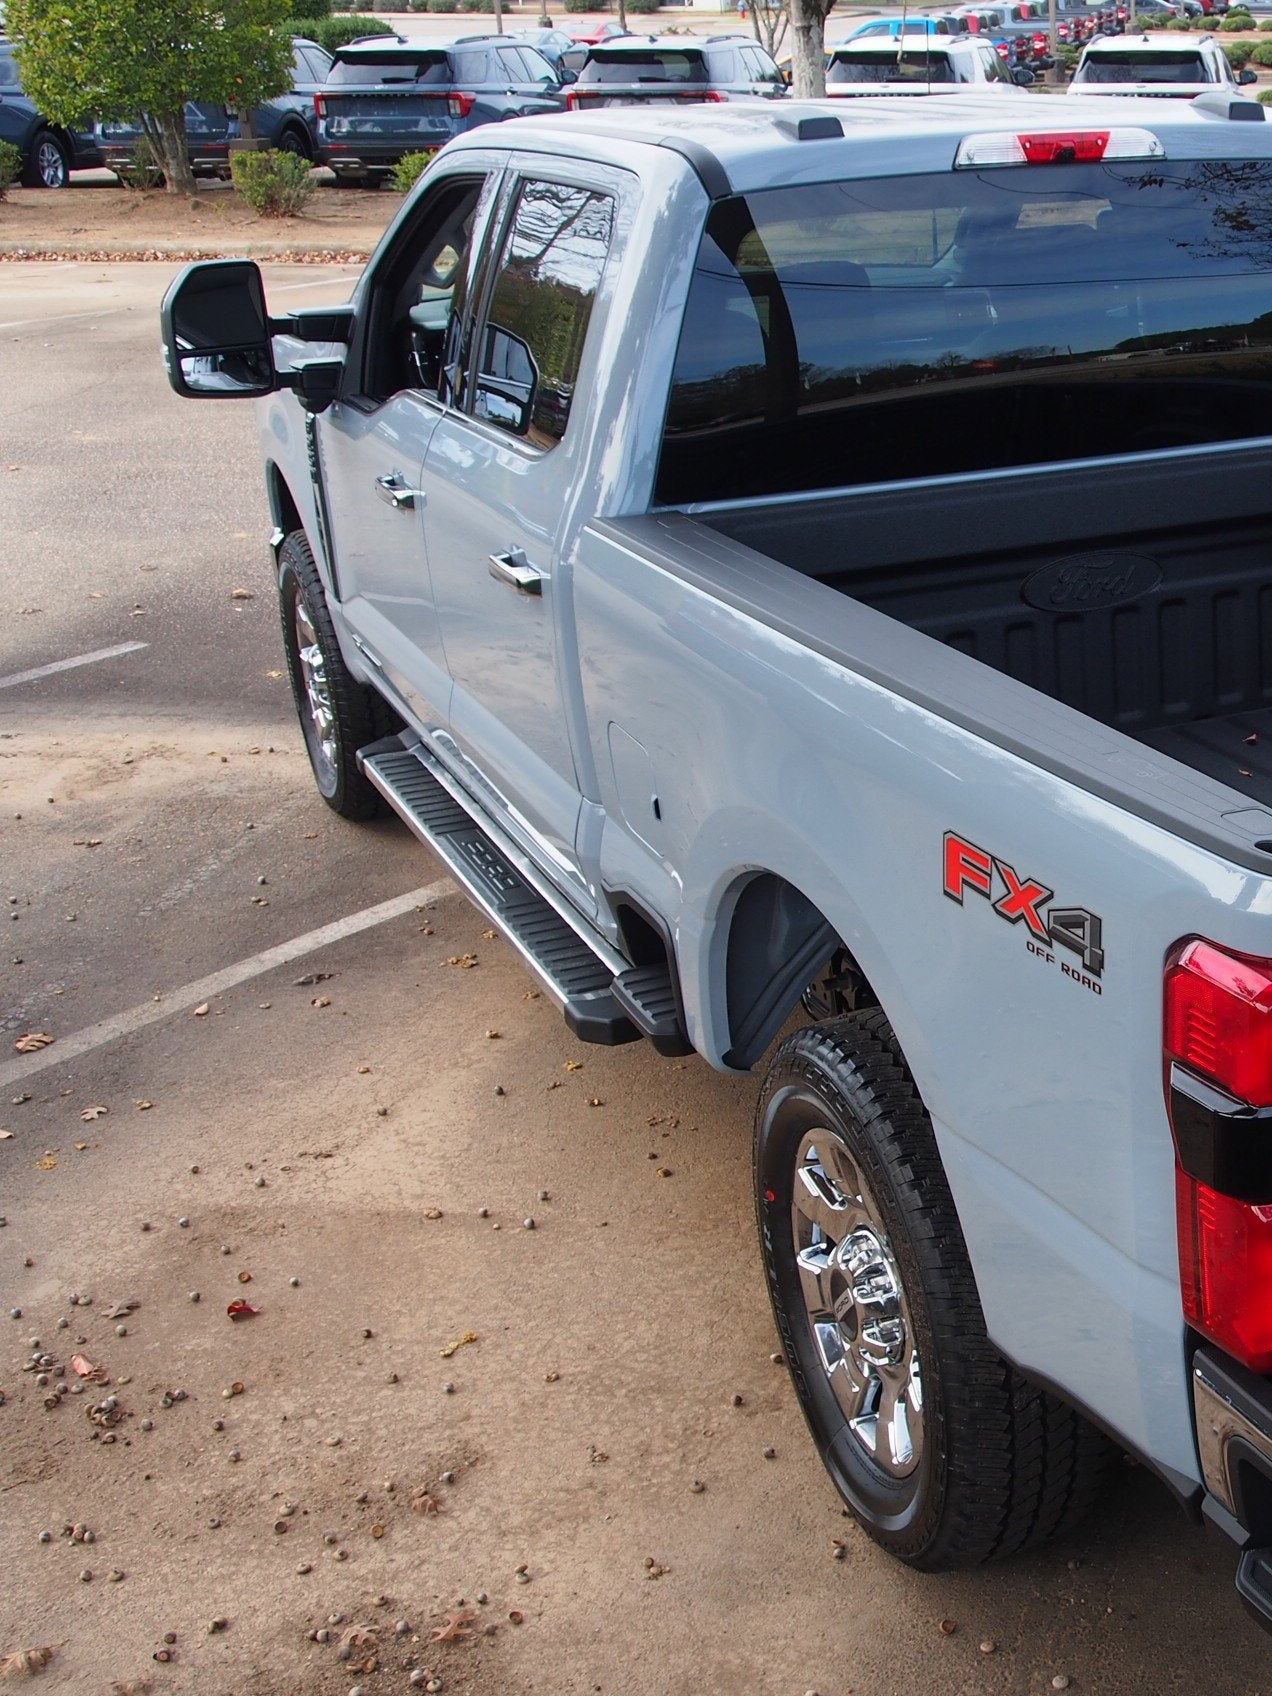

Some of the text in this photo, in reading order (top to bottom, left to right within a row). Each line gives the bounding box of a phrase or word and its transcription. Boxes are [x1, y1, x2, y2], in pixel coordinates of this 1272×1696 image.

[1049, 556, 1137, 606] Ford
[943, 829, 1105, 979] FX4
[1026, 940, 1103, 996] OFF ROAD
